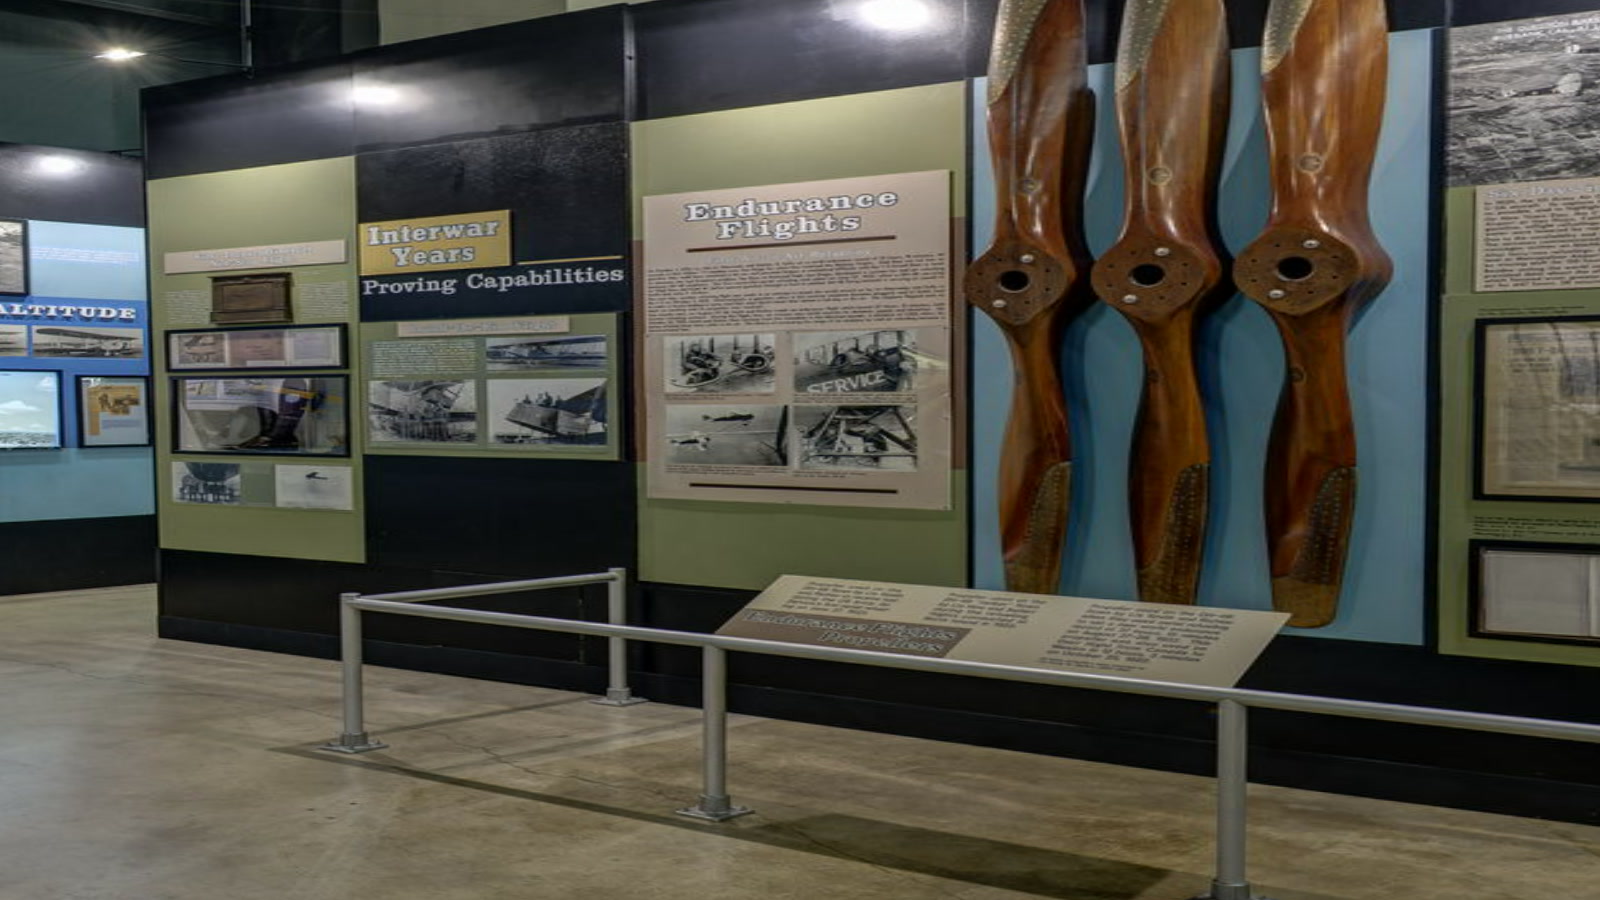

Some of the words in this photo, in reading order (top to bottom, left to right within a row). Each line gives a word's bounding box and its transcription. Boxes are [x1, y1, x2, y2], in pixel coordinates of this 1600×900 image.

[685, 191, 898, 222] Endurance
[367, 220, 499, 246] Interwar
[716, 215, 861, 240] Flights
[391, 246, 476, 267] Years
[363, 277, 457, 295] Proving
[466, 267, 625, 292] Capabilities
[806, 370, 886, 393] SERVICE
